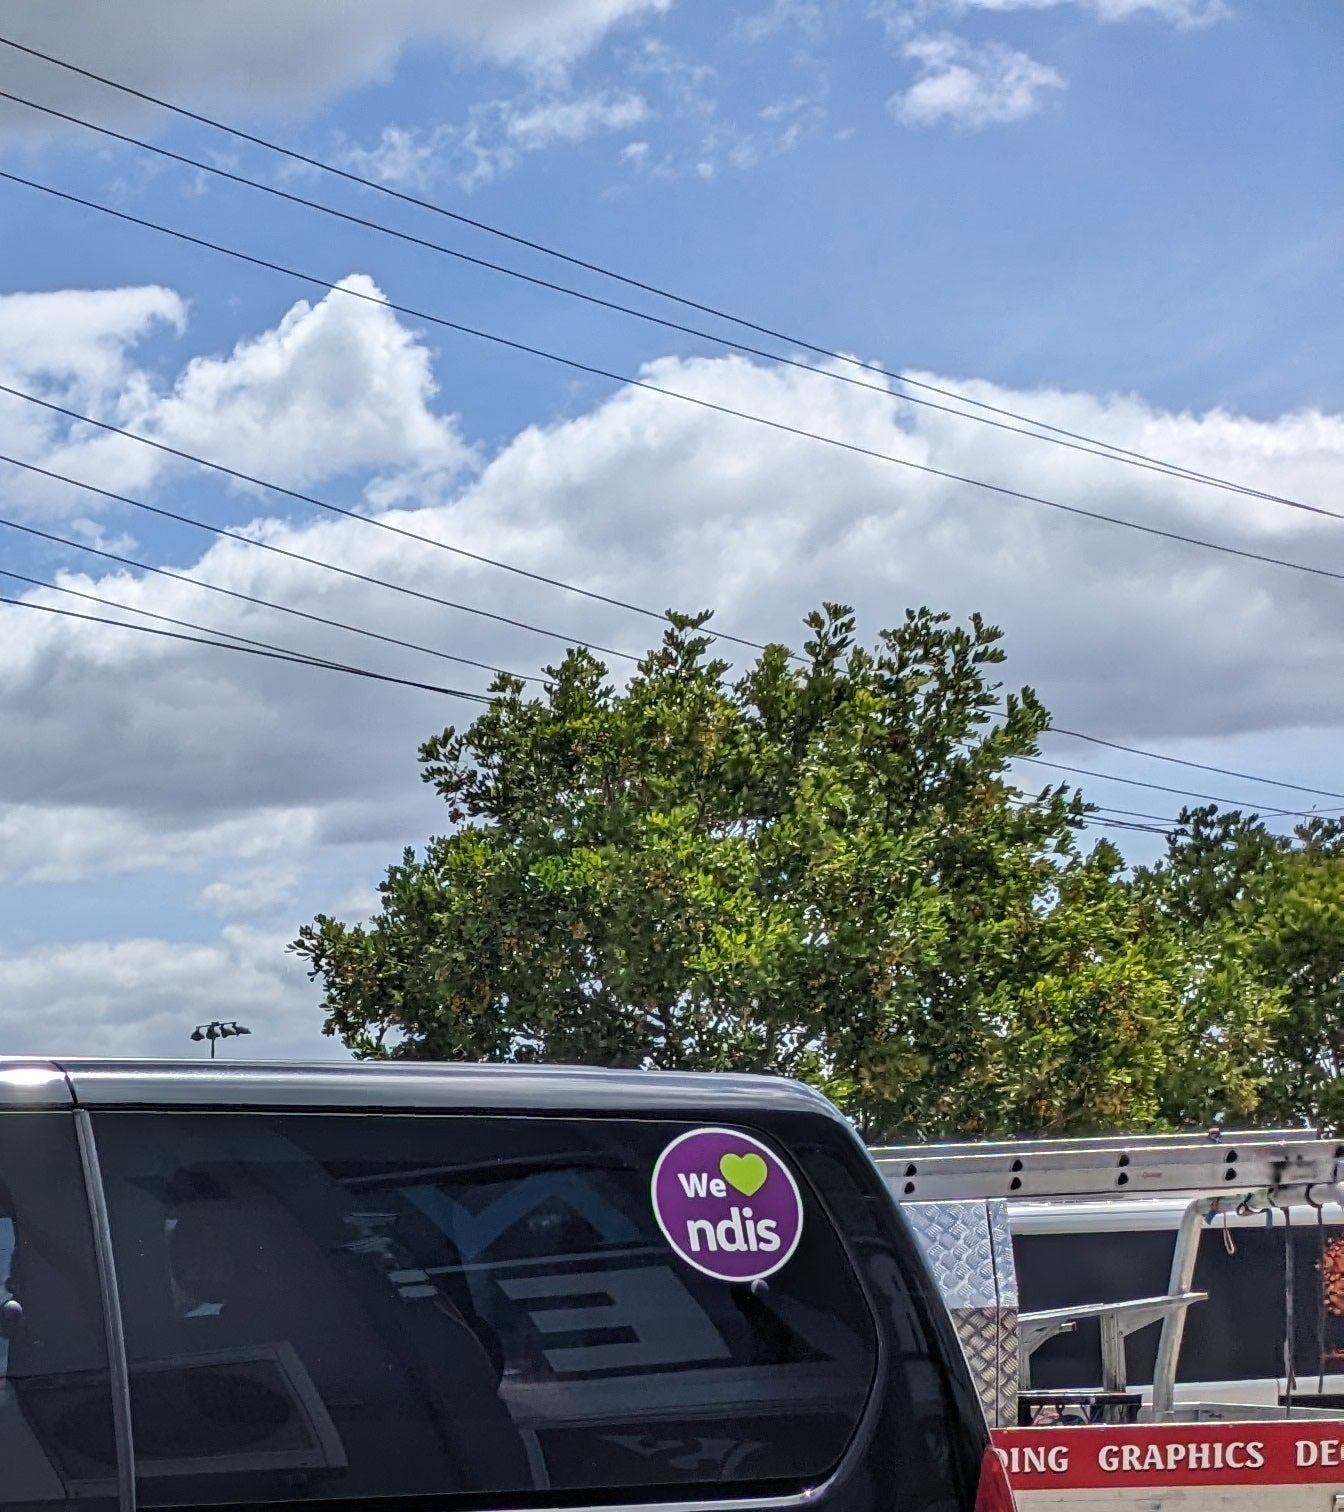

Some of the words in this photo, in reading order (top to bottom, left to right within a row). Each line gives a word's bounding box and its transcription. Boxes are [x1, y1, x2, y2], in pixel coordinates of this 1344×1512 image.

[677, 1172, 727, 1198] We
[686, 1206, 781, 1252] ndis
[1098, 1441, 1265, 1472] GRAPHICS
